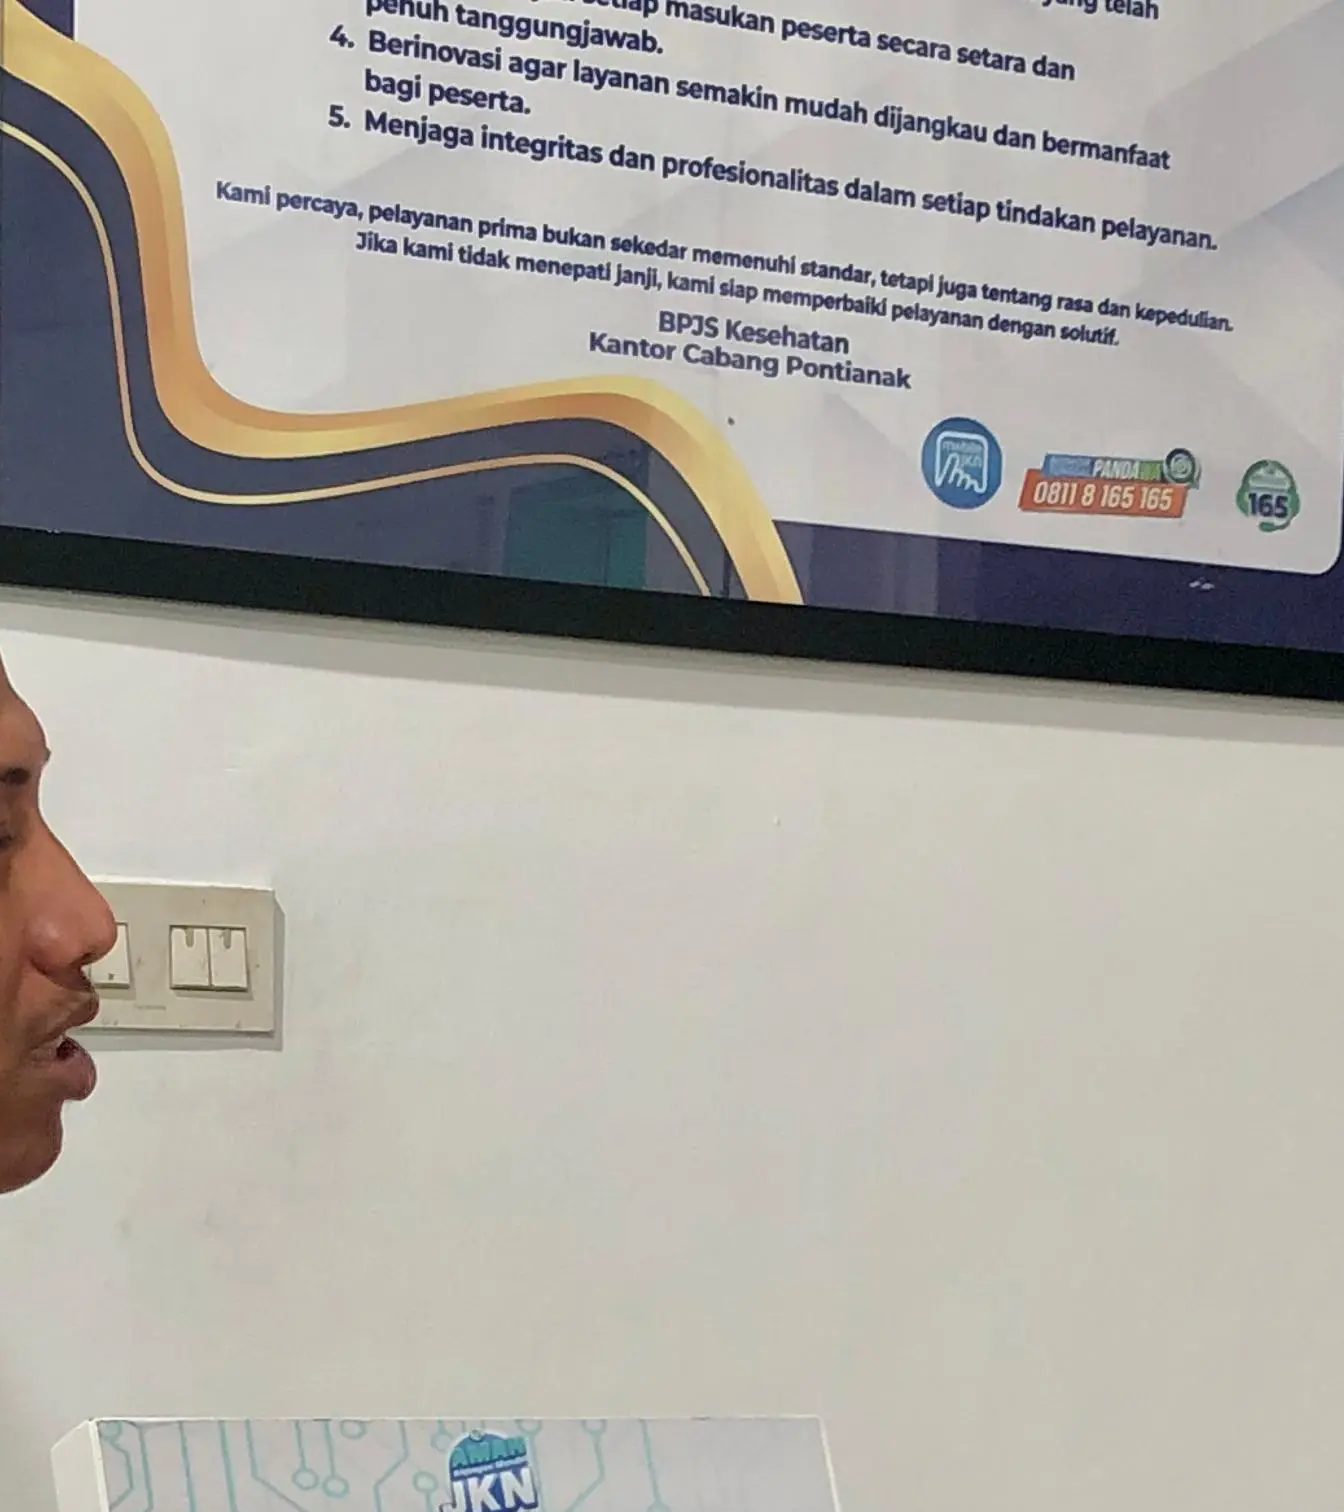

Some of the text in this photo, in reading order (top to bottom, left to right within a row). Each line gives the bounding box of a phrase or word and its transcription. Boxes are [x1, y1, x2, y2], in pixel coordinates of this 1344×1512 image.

[366, 0, 449, 22] penuh
[455, 4, 664, 54] tanggungjawab.
[664, 0, 775, 34] masukan
[781, 15, 871, 49] peserta
[877, 32, 951, 62] secara
[956, 45, 1026, 75] setara
[1032, 55, 1075, 81] dan
[329, 24, 1171, 170] 4. Berinovasi agar layanan semakin mudah dijangkau dan bermanfaat
[364, 68, 532, 116] bagi peserta.
[328, 104, 1219, 252] 5. Menjaga integritas dan profesionalitas dalam setiap tindakan pelayanan.
[215, 180, 271, 206] Kami
[276, 191, 364, 222] percaya,
[368, 203, 473, 234] pelayanan
[478, 216, 537, 242] prima
[542, 223, 605, 250] bukan
[610, 234, 686, 260] sekedar
[692, 247, 796, 275] memenuhi
[800, 260, 876, 288] standar,
[881, 269, 934, 296] tetapi
[936, 273, 977, 300] juga
[981, 282, 1053, 312] tentang
[1056, 294, 1094, 314] rasa
[1098, 298, 1130, 319] dan
[355, 231, 397, 255] Jika
[404, 236, 453, 262] kami
[458, 244, 511, 270] tidak
[515, 254, 611, 283] menepati
[615, 264, 663, 292] janji,
[667, 271, 715, 296] kami
[719, 278, 758, 302] siap
[763, 286, 887, 318] memperbaiki
[891, 302, 983, 331] pelayanan
[988, 314, 1055, 341] dengan
[589, 331, 913, 390] Kantor Cabang Pontianak
[658, 310, 850, 355] BPJS Kesehatan
[1033, 480, 1174, 512] 0811 8 165 165
[1247, 491, 1290, 519] 165
